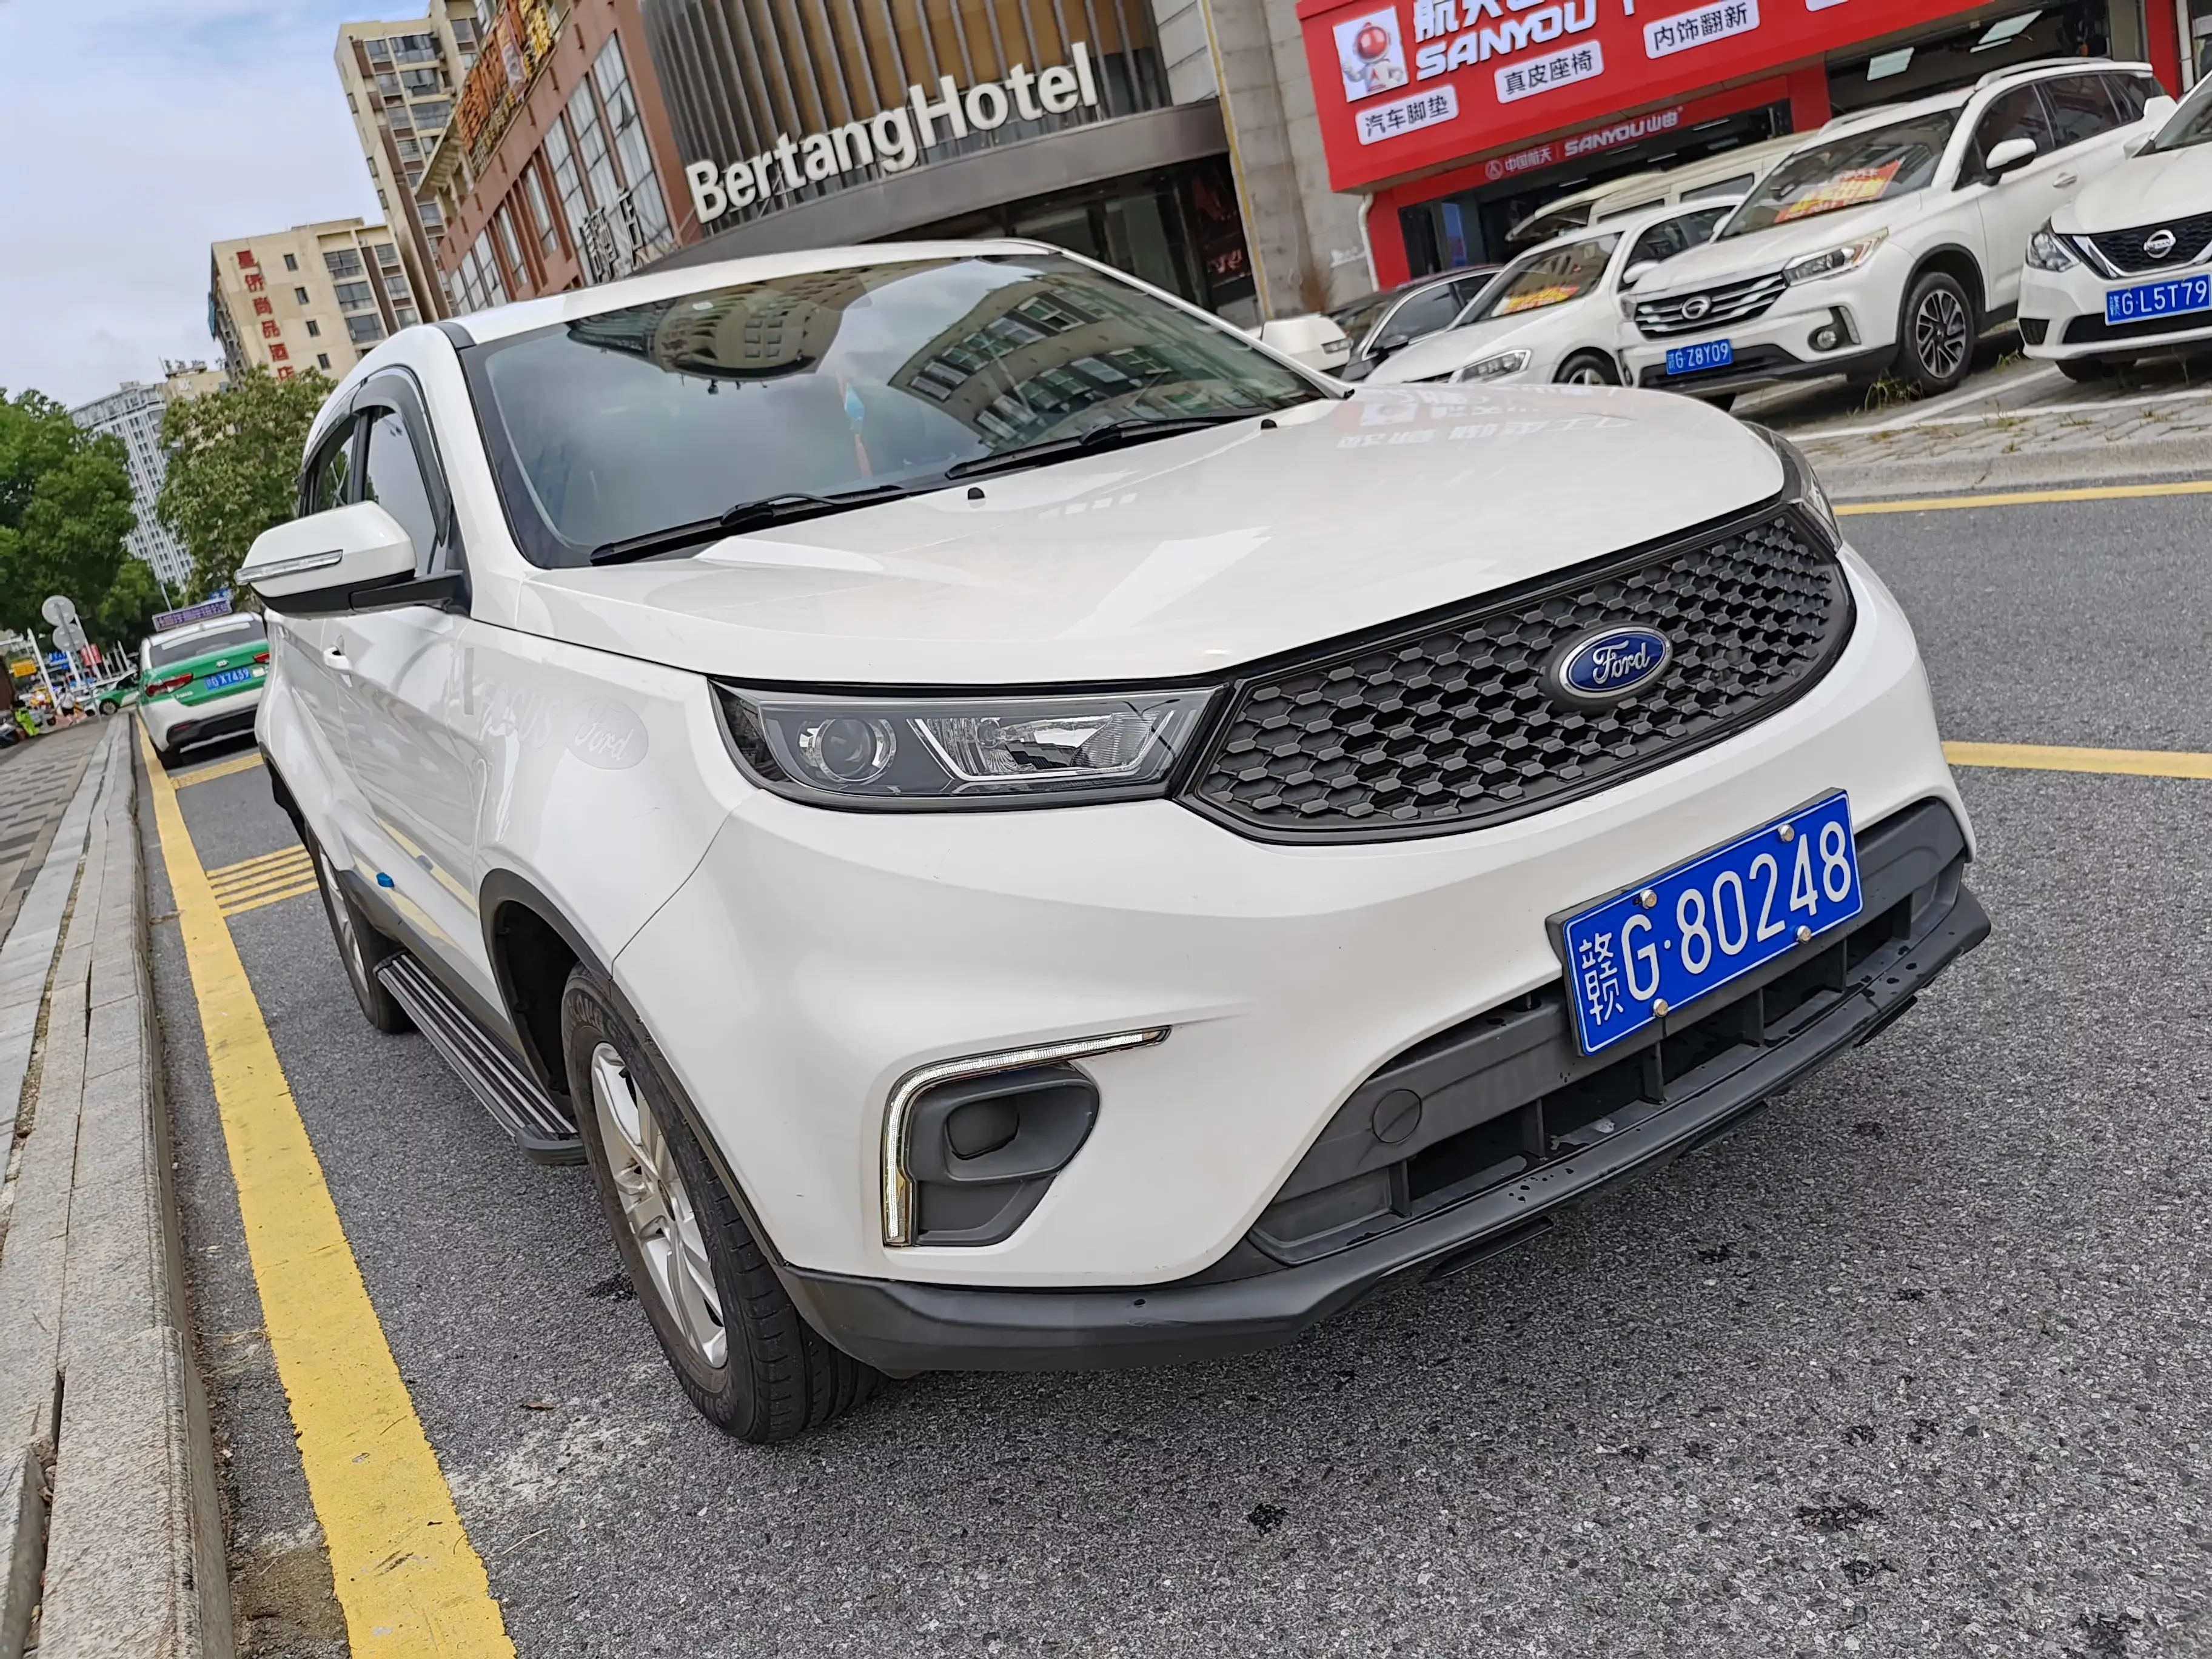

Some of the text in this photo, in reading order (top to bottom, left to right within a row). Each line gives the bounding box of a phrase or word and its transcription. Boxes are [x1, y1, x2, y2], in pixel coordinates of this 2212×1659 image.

[1416, 0, 1597, 81] SANYOU
[1653, 2, 1748, 51] 内饰翻新
[1503, 50, 1593, 96] 真皮座椅
[1365, 95, 1449, 138] 汽车脚垫
[1592, 640, 1651, 685] Ford
